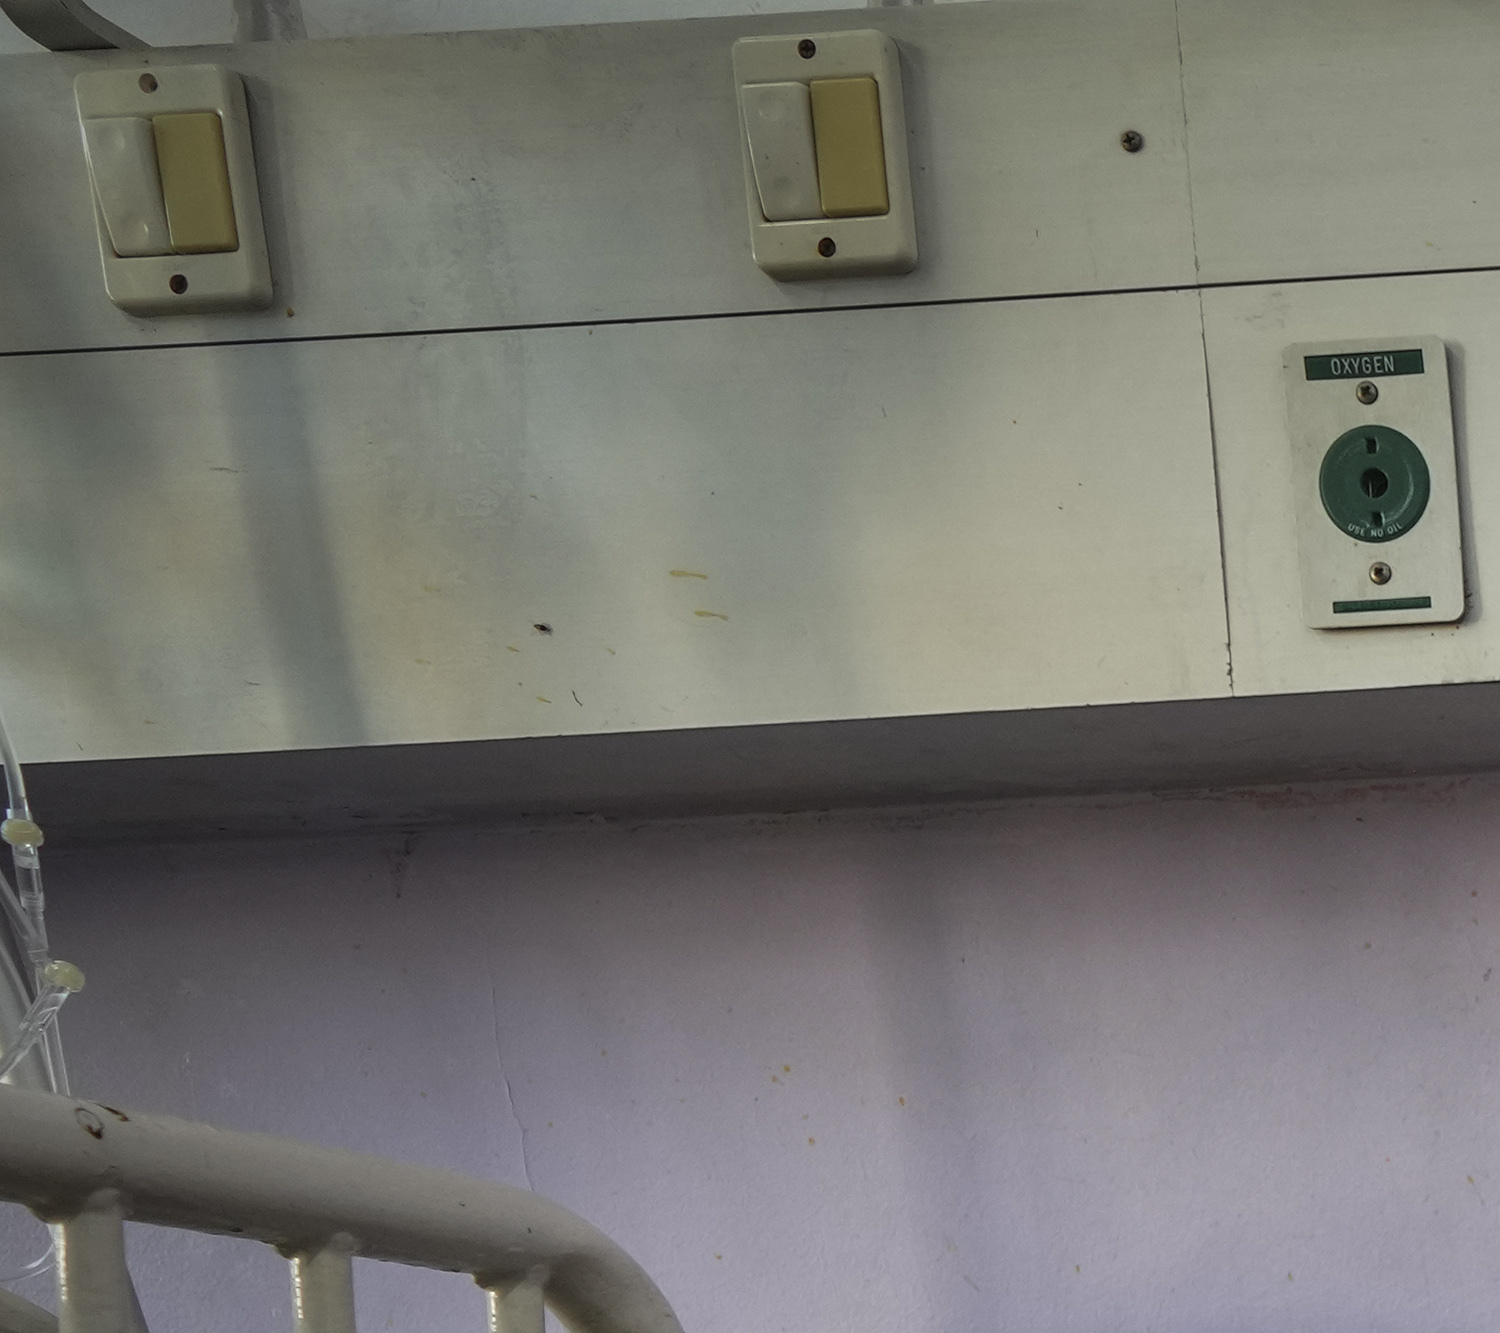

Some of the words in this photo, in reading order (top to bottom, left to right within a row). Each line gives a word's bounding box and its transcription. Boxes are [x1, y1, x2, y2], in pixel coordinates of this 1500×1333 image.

[1330, 354, 1396, 376] OXYGEN
[1348, 523, 1366, 537] USE
[1370, 528, 1384, 537] NO
[1387, 523, 1404, 536] OIL
